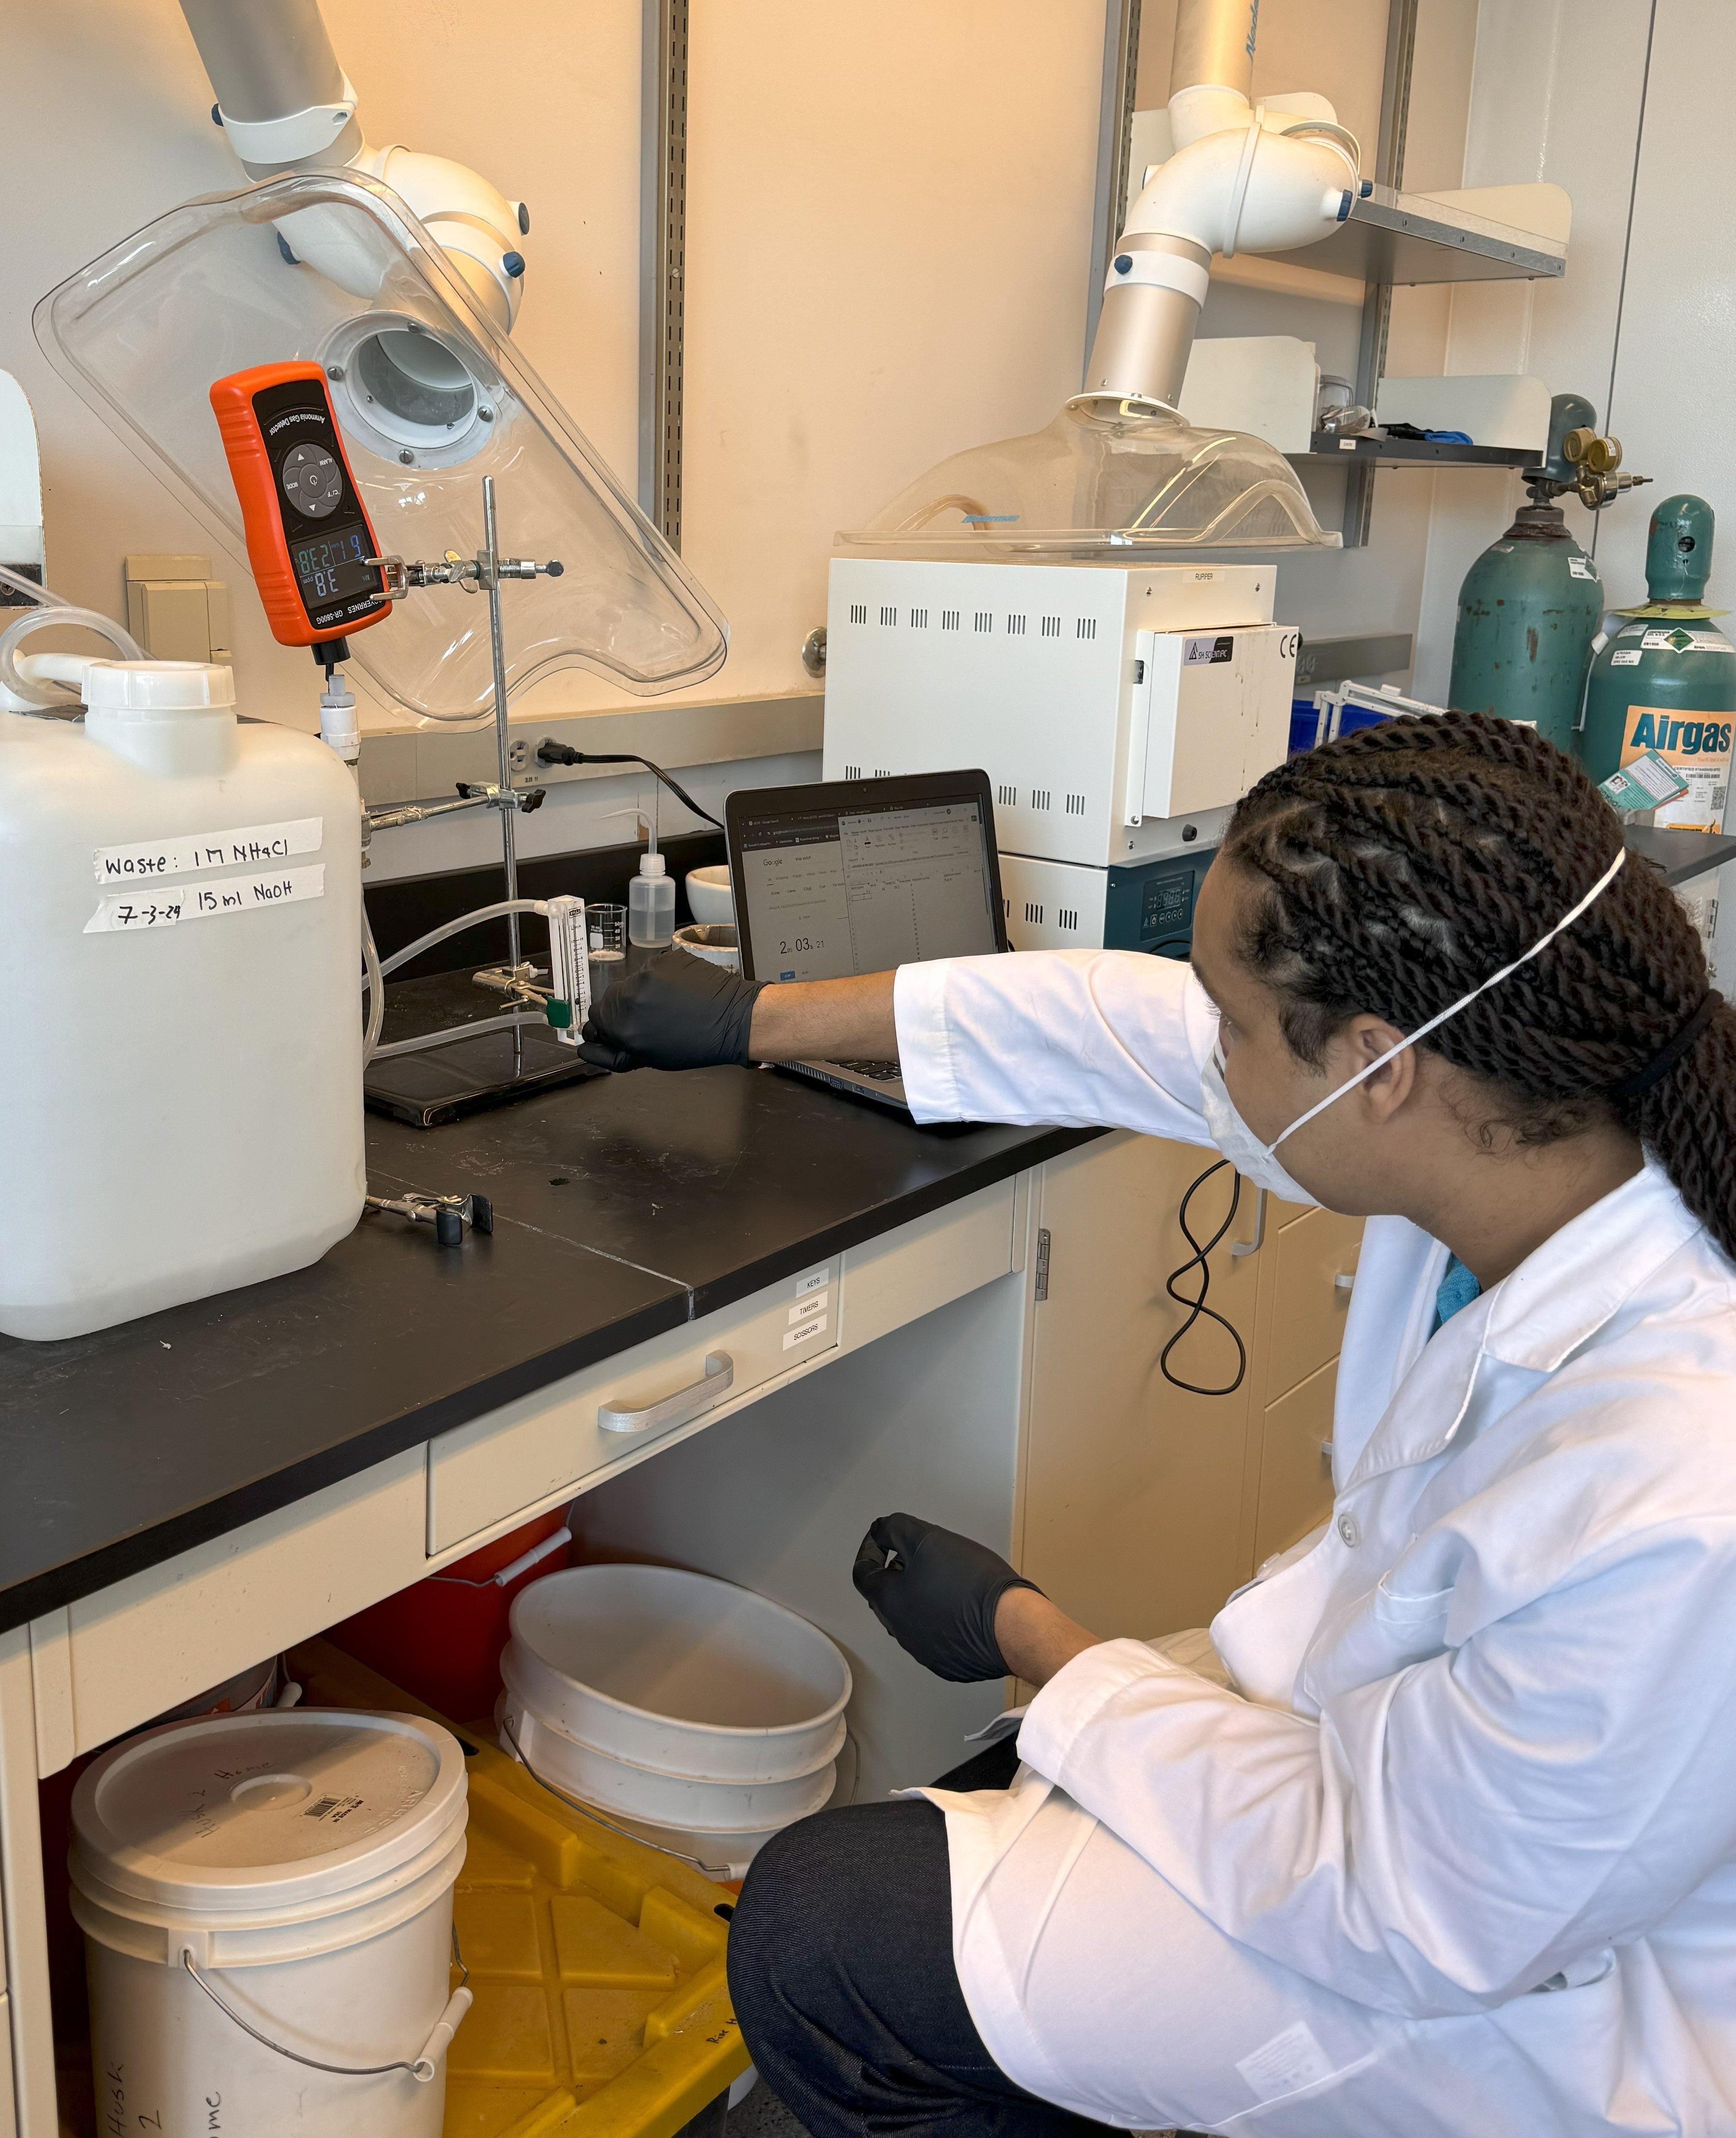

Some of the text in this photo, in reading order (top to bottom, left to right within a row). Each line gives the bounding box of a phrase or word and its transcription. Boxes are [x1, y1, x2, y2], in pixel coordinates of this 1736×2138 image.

[269, 414, 325, 435] Ammonia Gas Detector
[302, 568, 339, 597] 3.8 ppm
[316, 610, 343, 624] GR-5800G
[1280, 634, 1297, 658] CE
[1630, 713, 1731, 755] Airgas
[253, 880, 292, 901] NaOH
[118, 905, 180, 924] 7-3-24
[807, 1277, 820, 1288] KEYS
[800, 1301, 818, 1315] TIMERS
[794, 1324, 818, 1340] SCISSORS
[138, 2110, 162, 2130] 2
